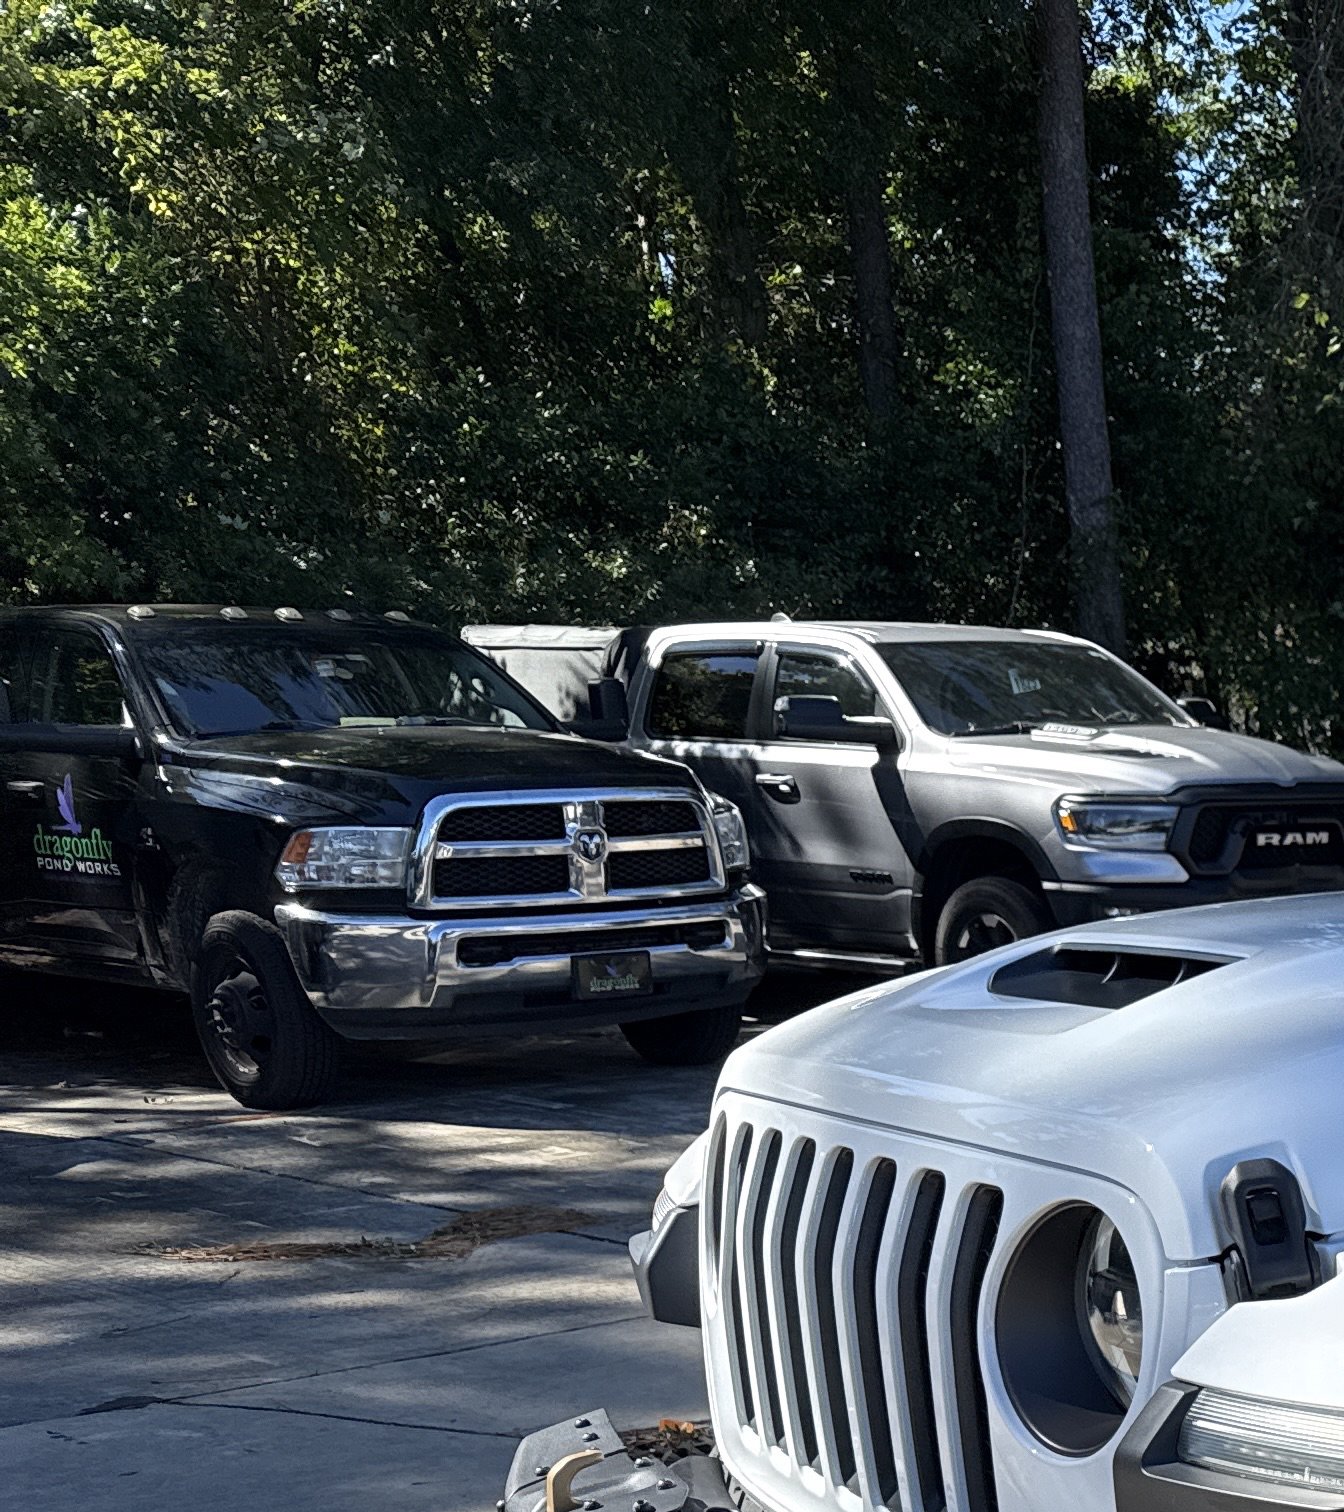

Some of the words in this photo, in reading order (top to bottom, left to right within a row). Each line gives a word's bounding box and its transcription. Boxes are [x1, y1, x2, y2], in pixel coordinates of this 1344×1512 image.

[33, 823, 113, 866] dragonfly
[1256, 831, 1329, 846] RAM
[36, 857, 72, 872] POND
[76, 860, 121, 876] WORKS
